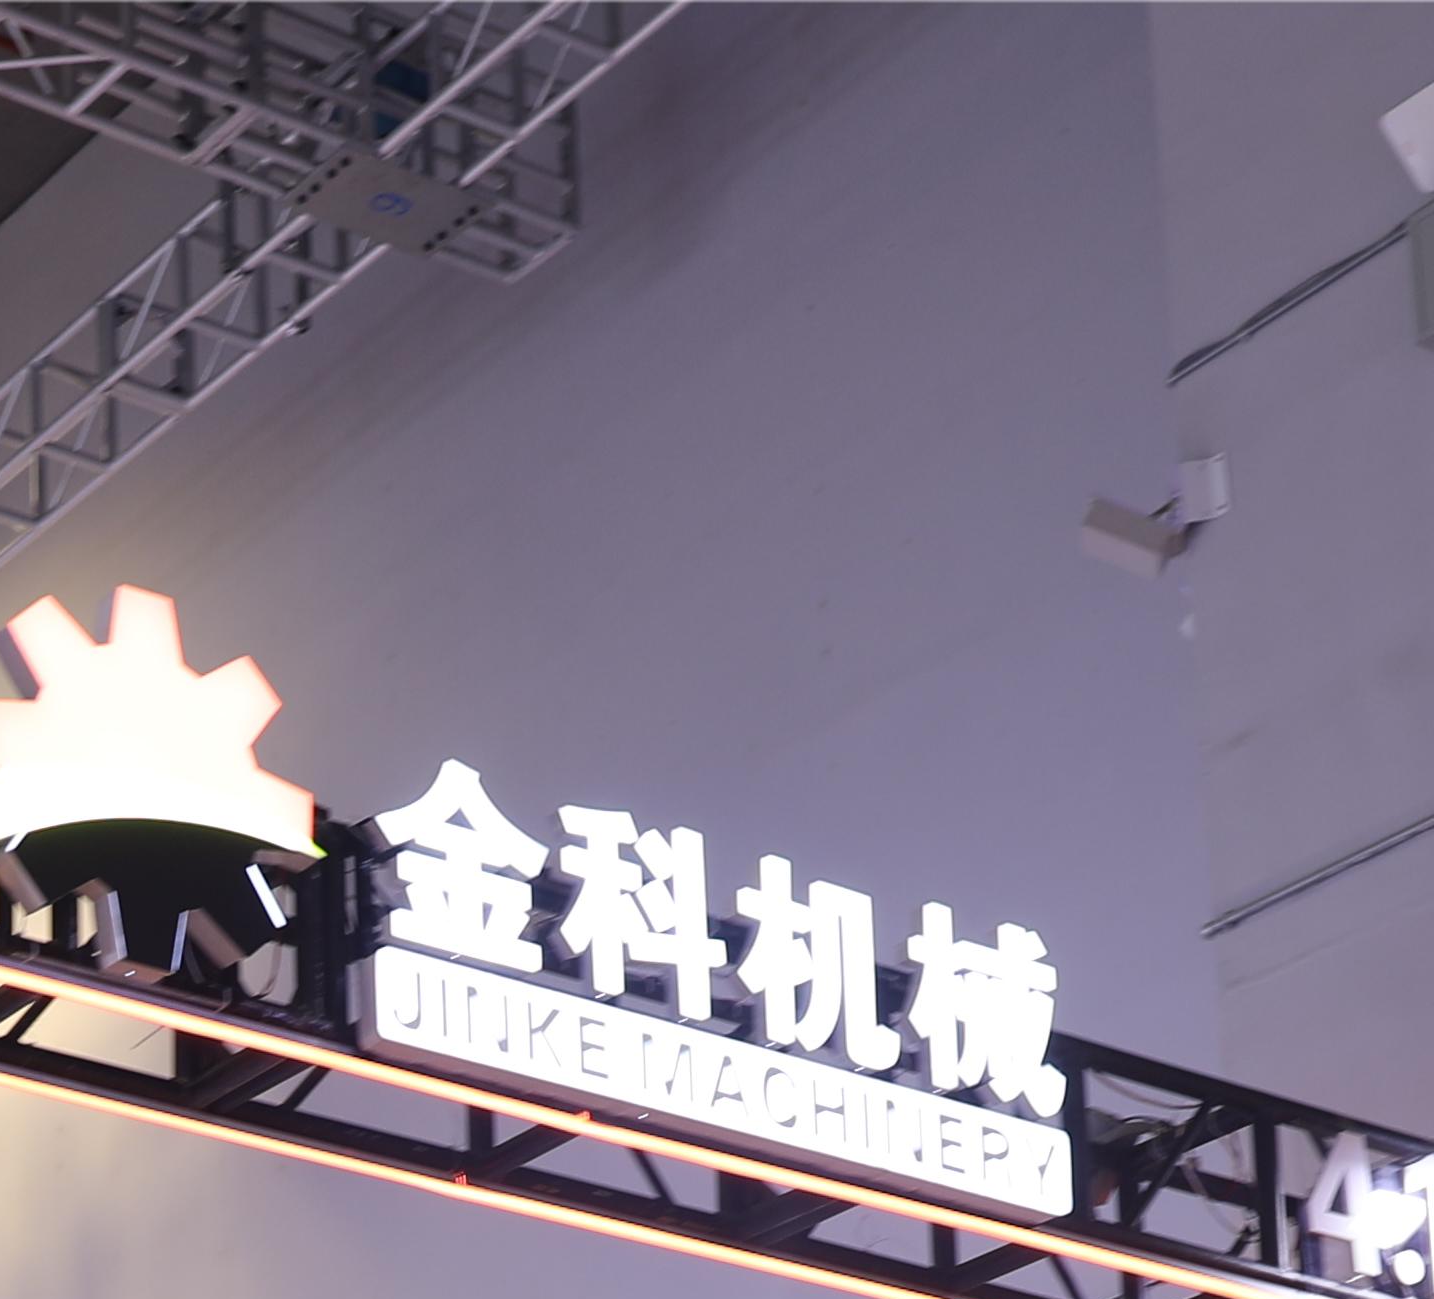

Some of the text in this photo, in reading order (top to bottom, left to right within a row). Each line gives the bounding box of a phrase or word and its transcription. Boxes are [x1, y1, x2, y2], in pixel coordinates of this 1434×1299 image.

[374, 757, 1066, 1117] 金科机械
[393, 969, 1055, 1198] JINKE MACHINERY
